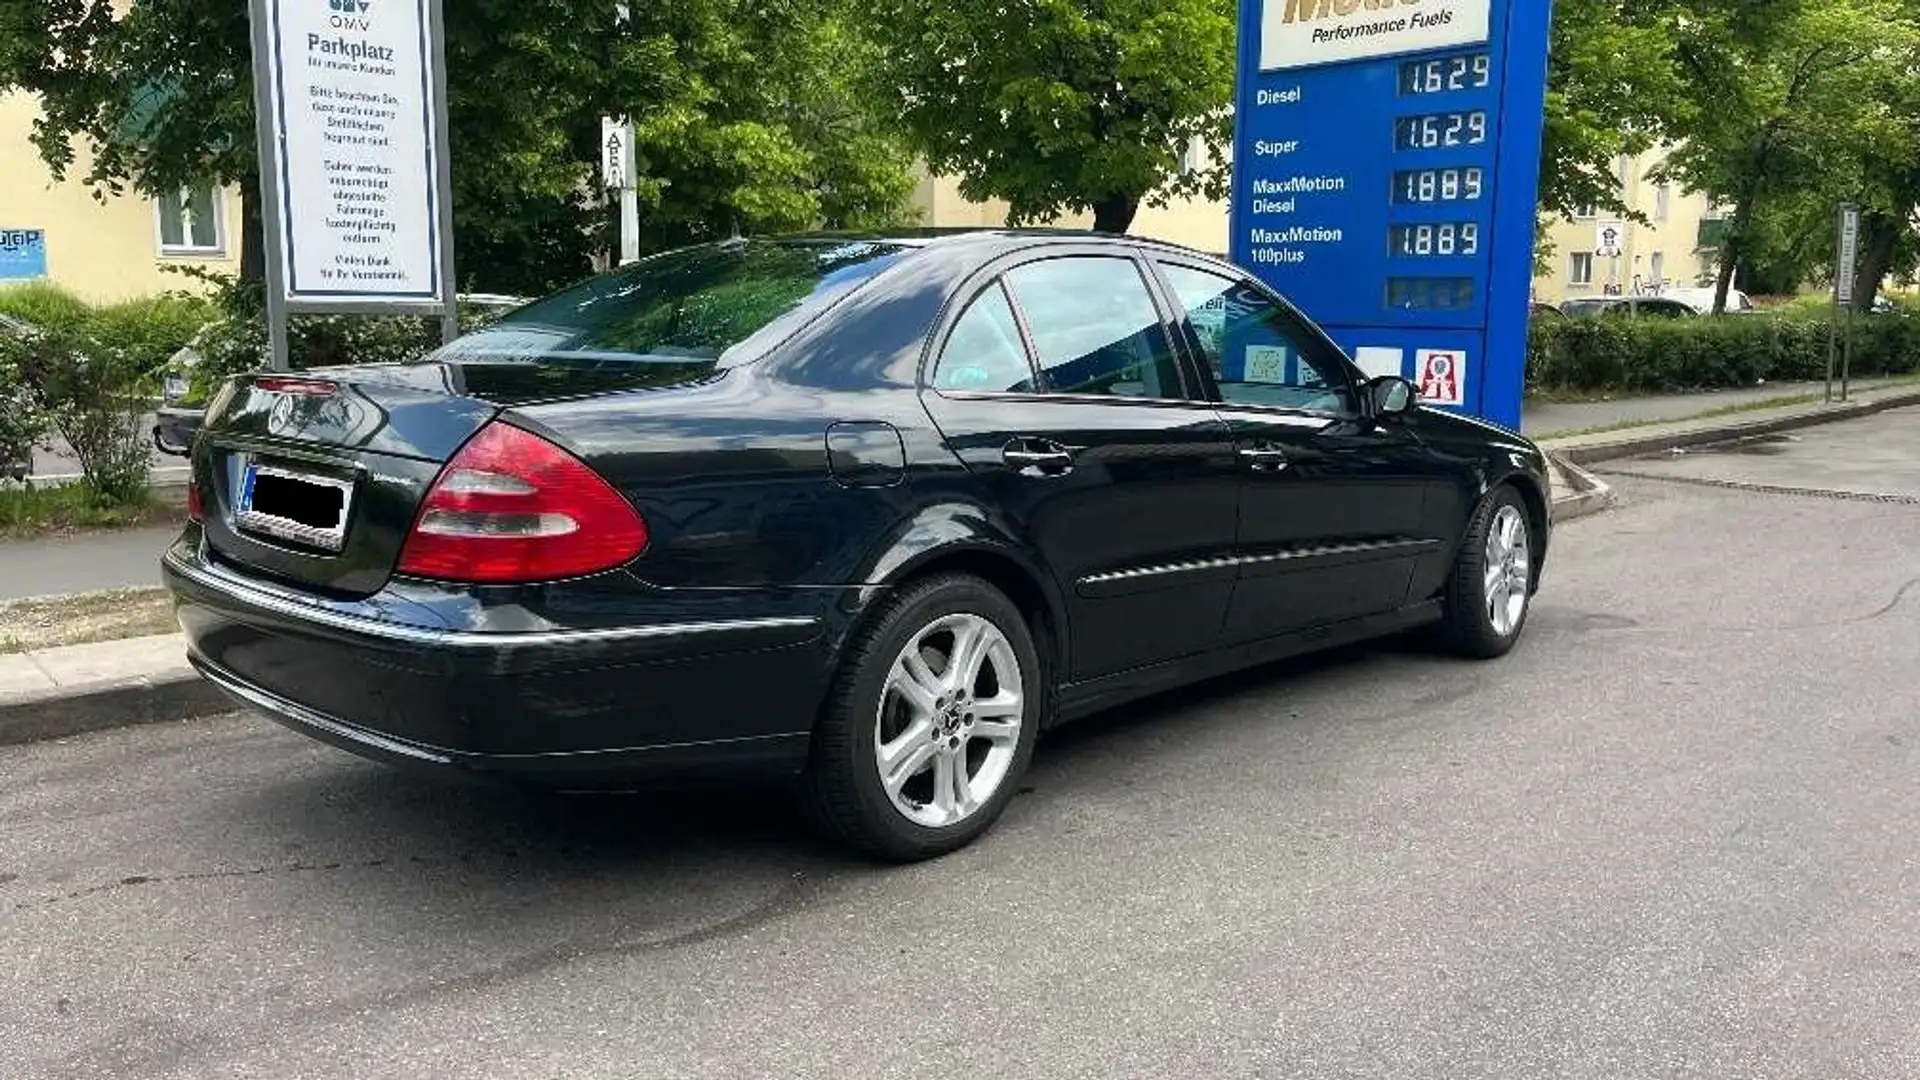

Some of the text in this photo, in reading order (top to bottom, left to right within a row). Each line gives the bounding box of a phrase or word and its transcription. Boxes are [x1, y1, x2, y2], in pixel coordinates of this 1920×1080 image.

[329, 15, 370, 31] OMV
[1312, 18, 1406, 43] Performance
[1410, 9, 1453, 29] Fuels
[307, 32, 394, 62] Parkplatz
[1412, 54, 1490, 93] 1.629
[1256, 86, 1300, 106] Diesel
[1409, 111, 1486, 149] 1.629
[1255, 139, 1299, 157] Super
[1252, 176, 1345, 195] MaxxMotion
[1406, 168, 1482, 202] 1.889
[1253, 197, 1295, 215] Diesel
[1251, 226, 1343, 244] MaxxMotion
[1403, 222, 1478, 255] 1.889
[1251, 248, 1305, 266] 100plus
